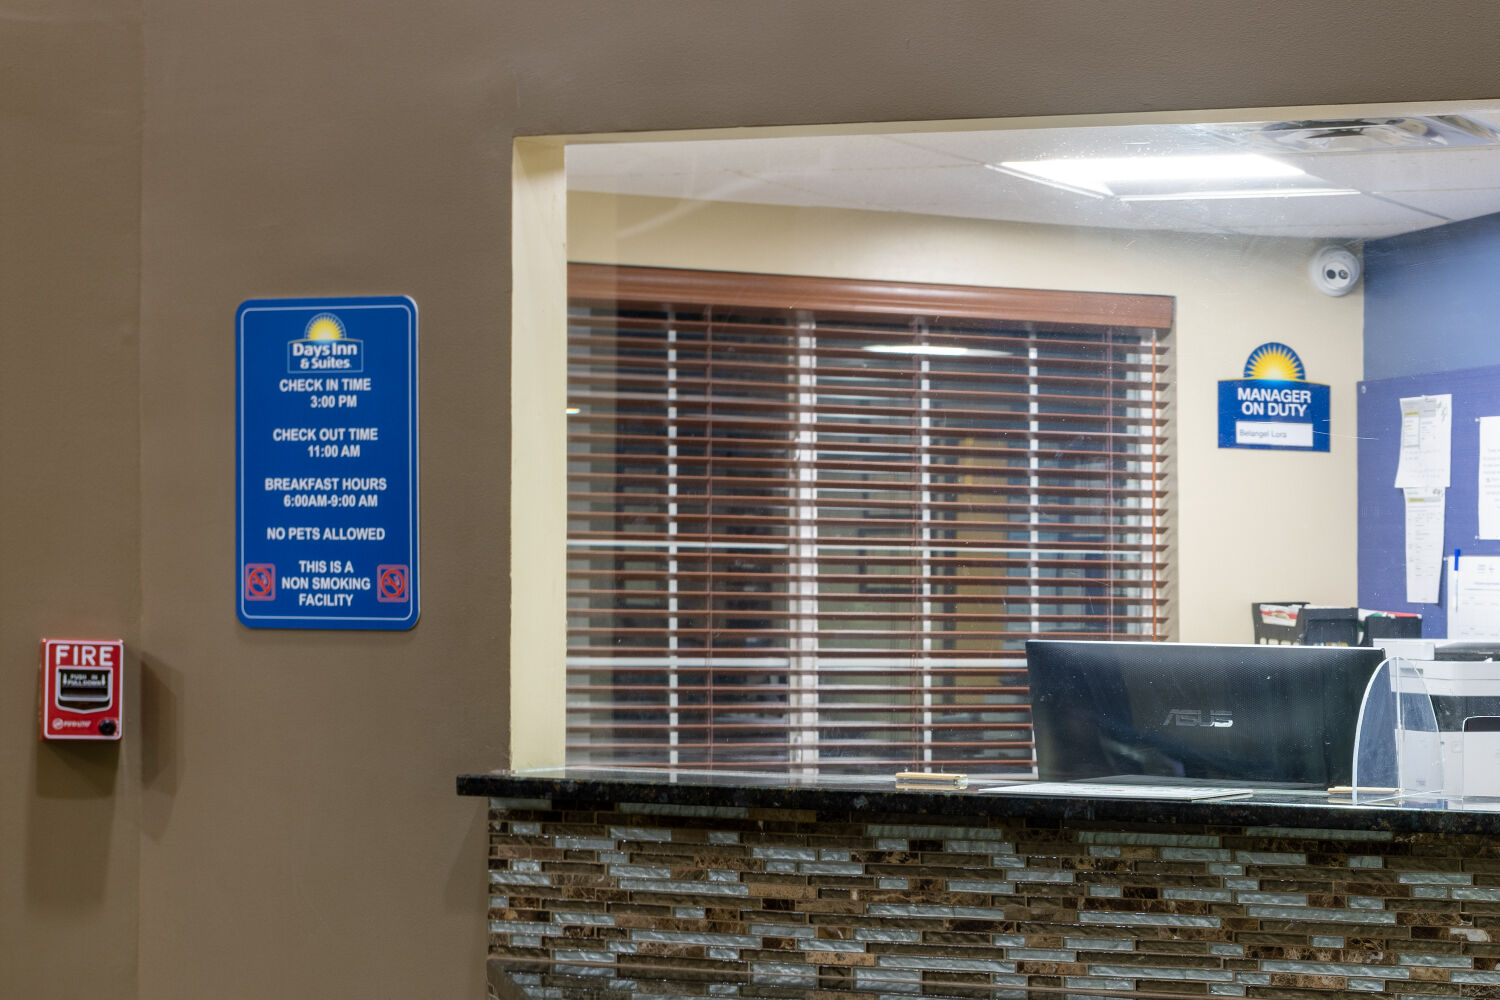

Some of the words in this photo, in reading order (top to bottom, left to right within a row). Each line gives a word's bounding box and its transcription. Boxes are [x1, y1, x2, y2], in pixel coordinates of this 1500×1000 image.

[293, 342, 330, 358] Days
[332, 342, 358, 355] Inn
[300, 357, 309, 369] &
[311, 356, 350, 369] Suites
[279, 378, 323, 392] CHECK
[326, 378, 339, 391] IN
[341, 377, 371, 391] TIME
[310, 395, 336, 408] 3:00
[338, 395, 357, 407] PM
[1237, 387, 1312, 403] MANAGER
[1241, 402, 1264, 415] ON
[1268, 403, 1307, 417] DUTY
[272, 428, 317, 441] CHECK
[320, 428, 346, 441] OUT
[348, 427, 378, 440] TIME
[307, 445, 339, 458] 11:00
[340, 445, 361, 457] AM
[264, 477, 339, 491] BREAKFAST
[342, 477, 387, 491] HOURS
[283, 494, 356, 508] 6:00AM-9:00
[358, 494, 378, 507] AM
[266, 527, 286, 540] NO
[289, 527, 321, 540] PETS
[322, 527, 386, 540] ALLOWED
[299, 561, 328, 573] THIS
[330, 560, 342, 573] IS
[344, 561, 354, 572] A
[281, 577, 310, 590] NON
[312, 577, 371, 590] SMOKING
[299, 593, 353, 607] FACILITY
[56, 645, 114, 666] FIRE
[1162, 709, 1233, 727] ASUS
